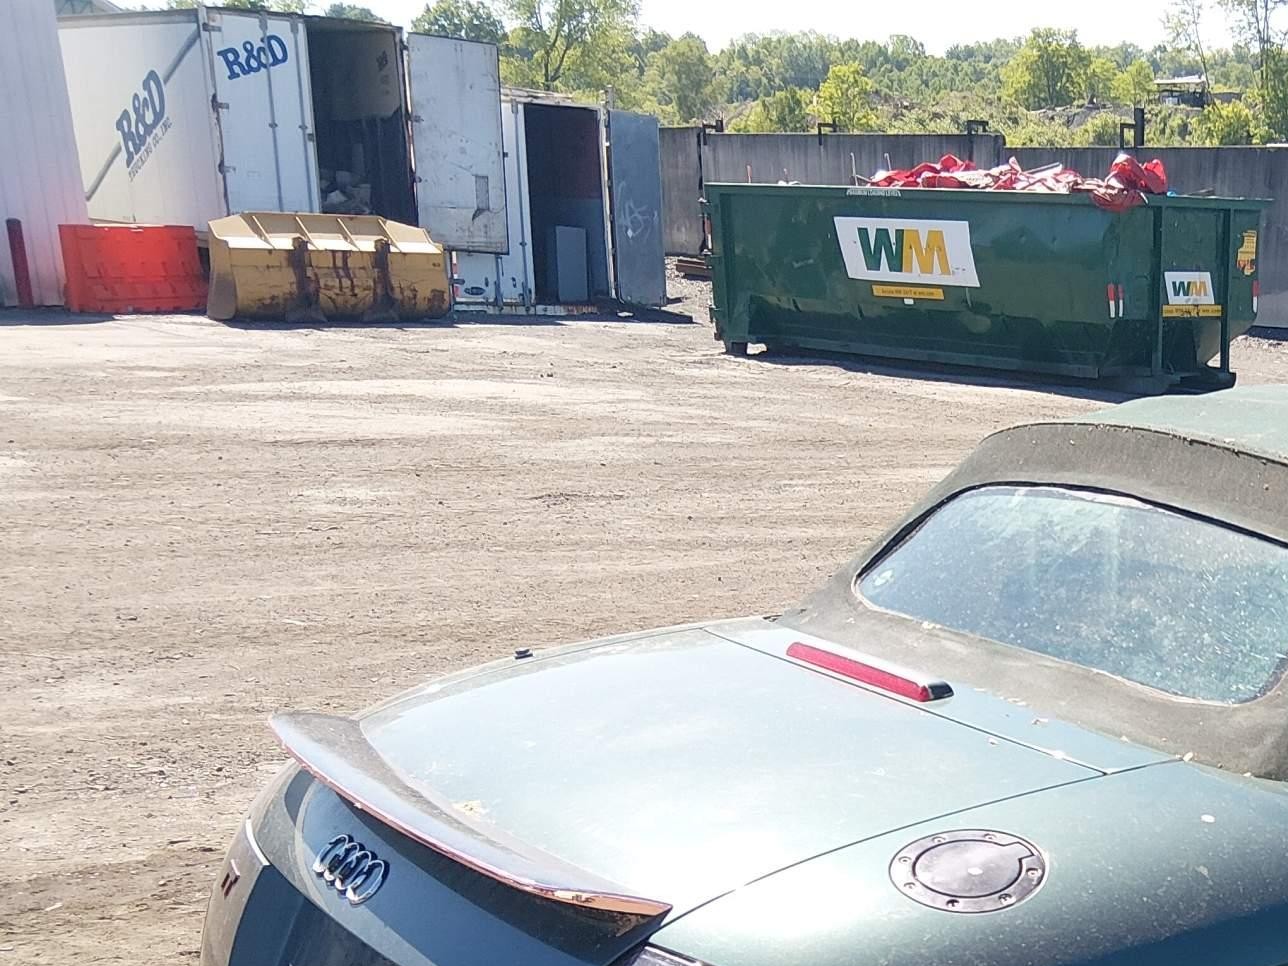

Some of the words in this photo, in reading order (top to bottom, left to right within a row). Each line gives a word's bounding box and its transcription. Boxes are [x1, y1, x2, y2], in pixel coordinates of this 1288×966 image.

[217, 34, 288, 80] R&D
[115, 69, 166, 169] R&D
[857, 227, 953, 276] WM
[1171, 280, 1208, 297] WM
